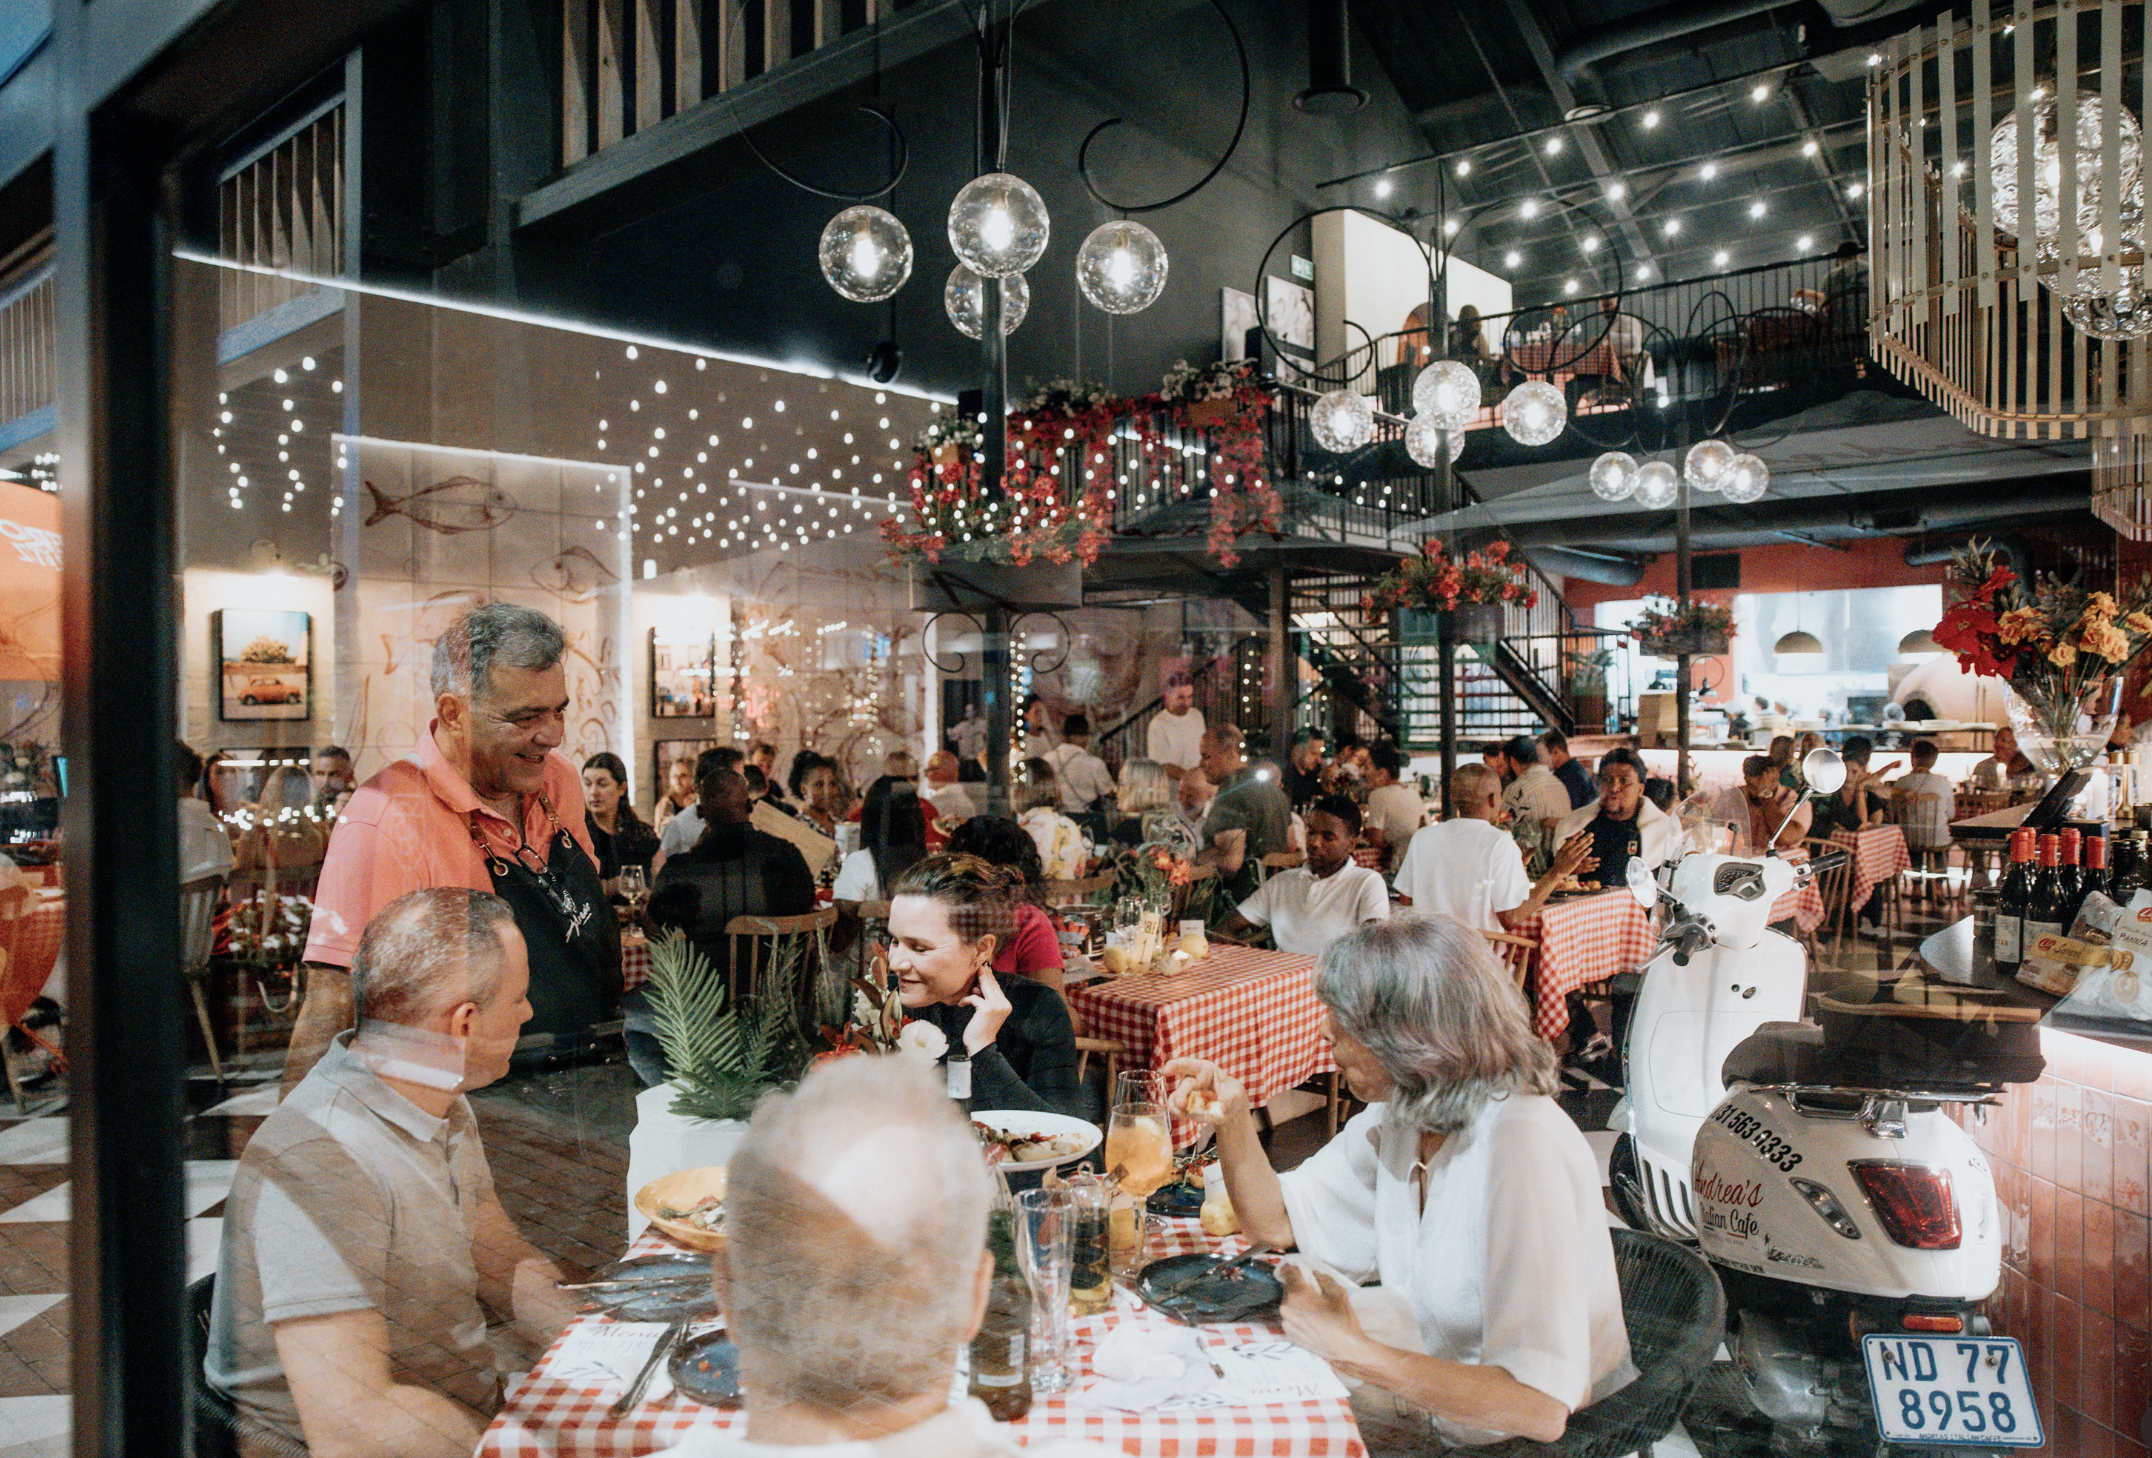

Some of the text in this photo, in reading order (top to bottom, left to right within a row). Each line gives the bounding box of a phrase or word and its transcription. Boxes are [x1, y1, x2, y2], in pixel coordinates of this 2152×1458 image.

[1730, 1208, 1760, 1239] Cafe
[592, 1325, 662, 1339] Menu
[1879, 1341, 2010, 1384] ND 77
[1899, 1388, 2017, 1433] 8958
